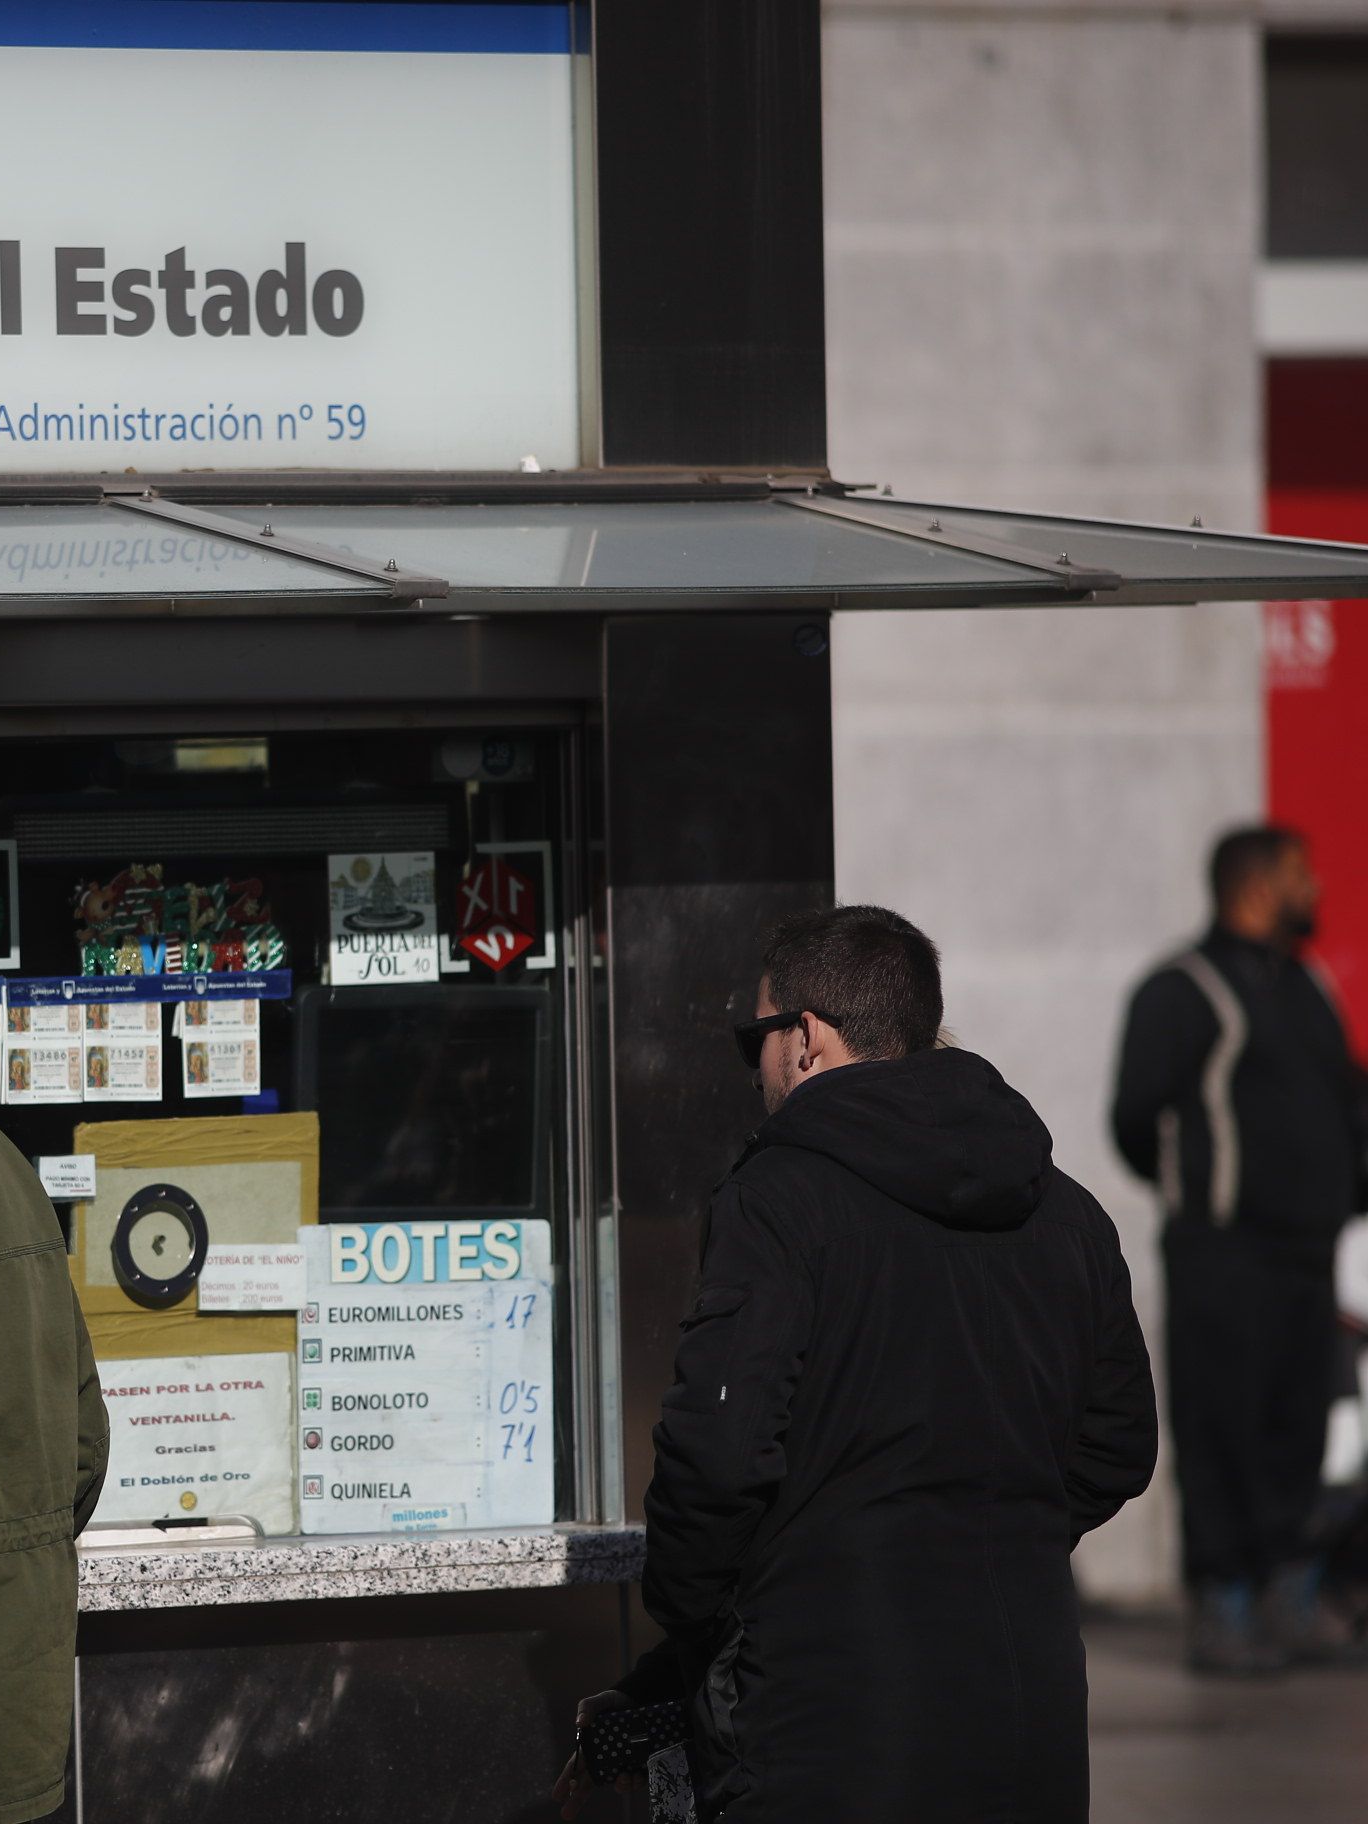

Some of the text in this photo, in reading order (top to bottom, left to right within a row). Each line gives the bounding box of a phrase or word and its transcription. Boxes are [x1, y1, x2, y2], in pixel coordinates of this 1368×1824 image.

[55, 242, 365, 338] Estado
[278, 404, 313, 441] nº
[328, 404, 366, 441] 59
[205, 1255, 240, 1265] OTERÍA
[243, 1255, 254, 1264] DE
[330, 1222, 521, 1283] BOTES
[328, 1304, 463, 1324] EUROMILLONES
[331, 1344, 415, 1362] PRIMITIVA
[101, 1380, 264, 1397] PASEN POR LA OTRA
[332, 1392, 429, 1412] BONOLOTO
[129, 1413, 235, 1426] VENTANILLA.
[156, 1444, 215, 1455] Gracias
[331, 1435, 394, 1452] GORDO
[121, 1472, 250, 1487] El Doblón de Oro
[331, 1483, 412, 1500] QUINIELA
[392, 1508, 448, 1522] millones
